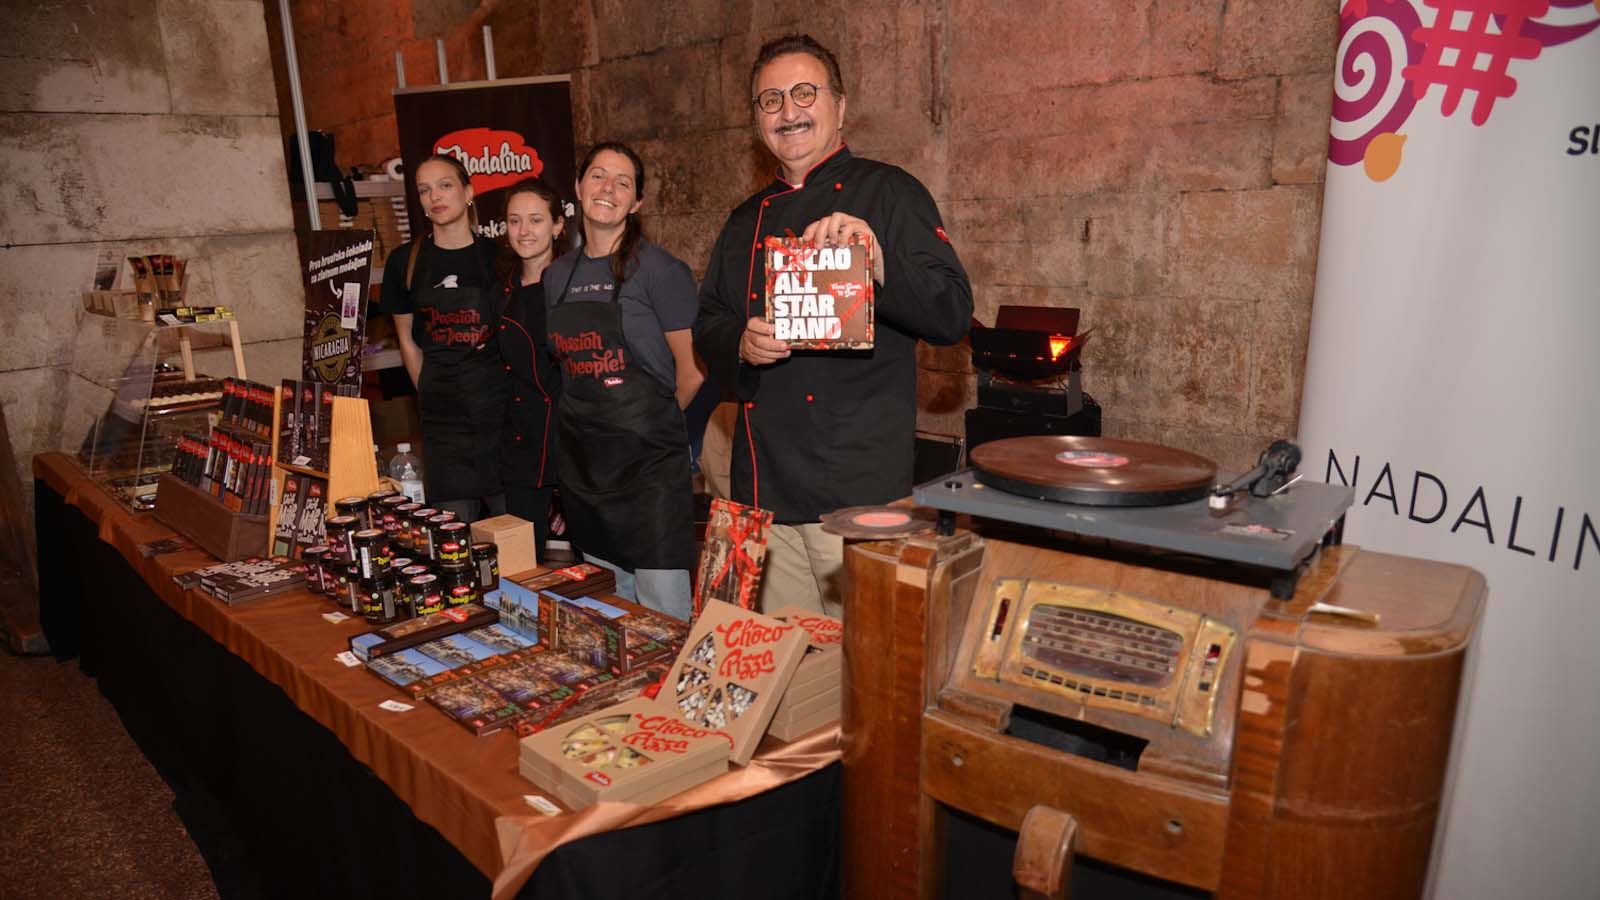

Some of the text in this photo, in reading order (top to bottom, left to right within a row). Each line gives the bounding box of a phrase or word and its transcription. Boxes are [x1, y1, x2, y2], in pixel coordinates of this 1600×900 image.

[437, 142, 532, 176] Nadalina
[774, 271, 818, 294] ALL
[774, 294, 835, 317] STAR
[775, 317, 842, 340] BAND
[314, 337, 349, 361] NICARAGUA
[548, 331, 604, 352] Passion
[565, 348, 625, 379] People!
[1325, 448, 1600, 570] NADALIN
[715, 618, 794, 648] Choco
[792, 615, 843, 633] Cho
[718, 648, 776, 680] Pizza
[634, 713, 728, 741] Choco
[622, 731, 688, 754] Pizza
